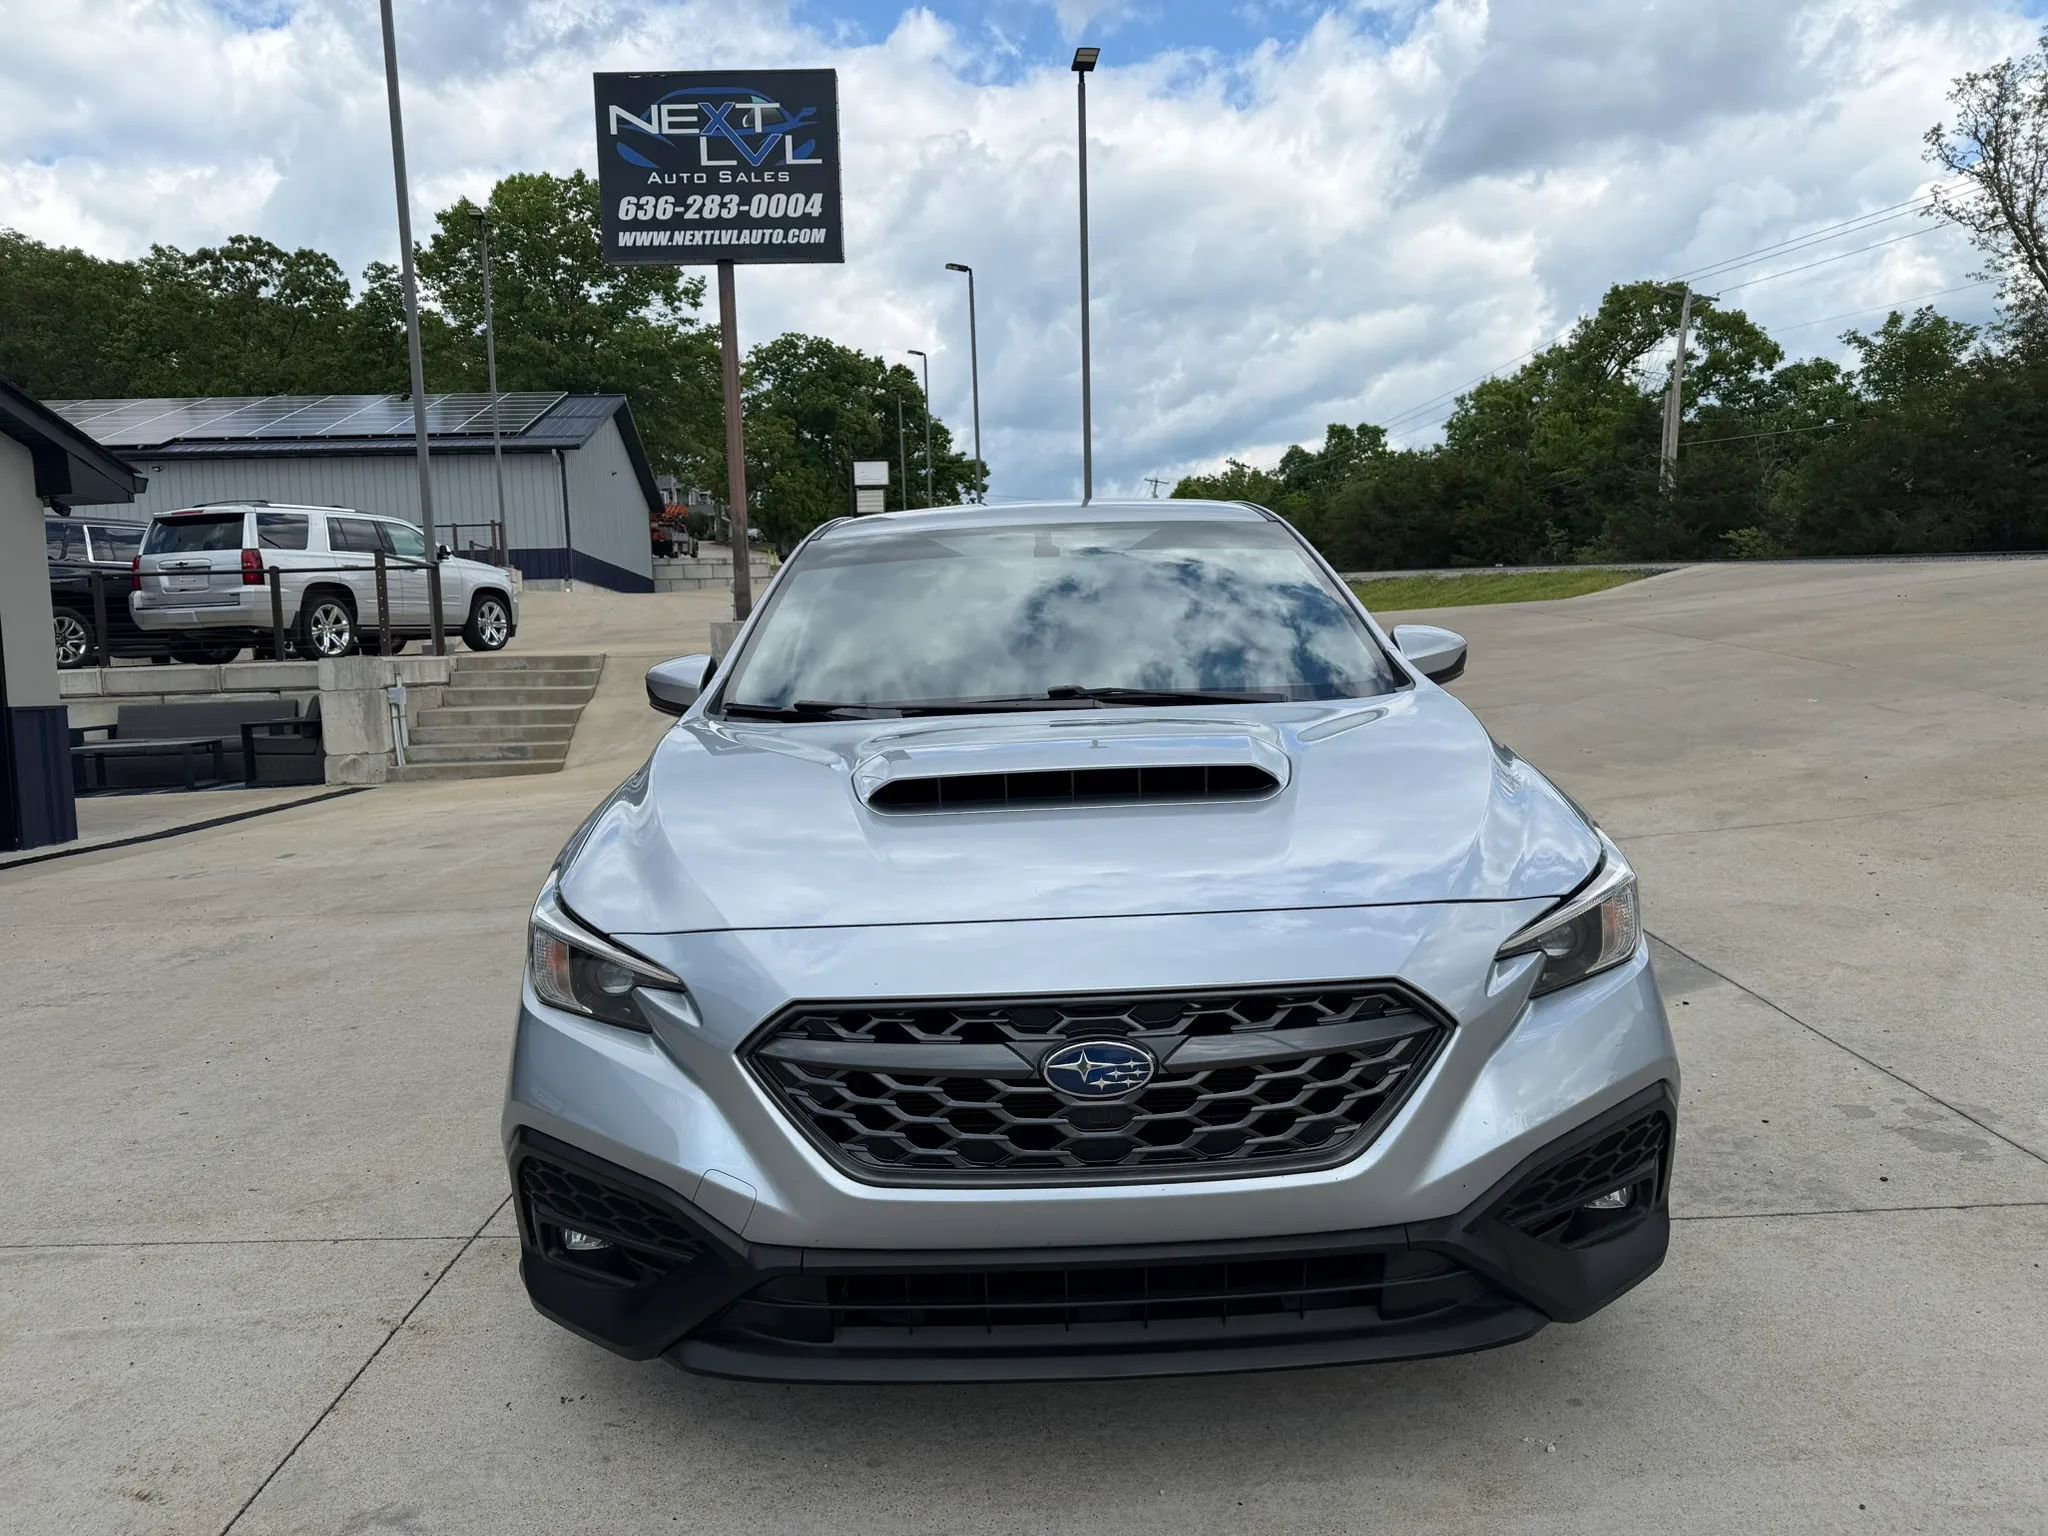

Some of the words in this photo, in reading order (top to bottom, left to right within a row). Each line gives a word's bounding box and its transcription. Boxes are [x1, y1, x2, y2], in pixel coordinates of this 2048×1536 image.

[609, 101, 780, 135] NEXT
[700, 133, 823, 167] LVL
[647, 171, 707, 184] AUTO
[719, 171, 790, 183] SALES
[618, 193, 824, 221] 636-283-0004
[618, 228, 827, 247] WWW.NEXTLVLAUTO.COM
